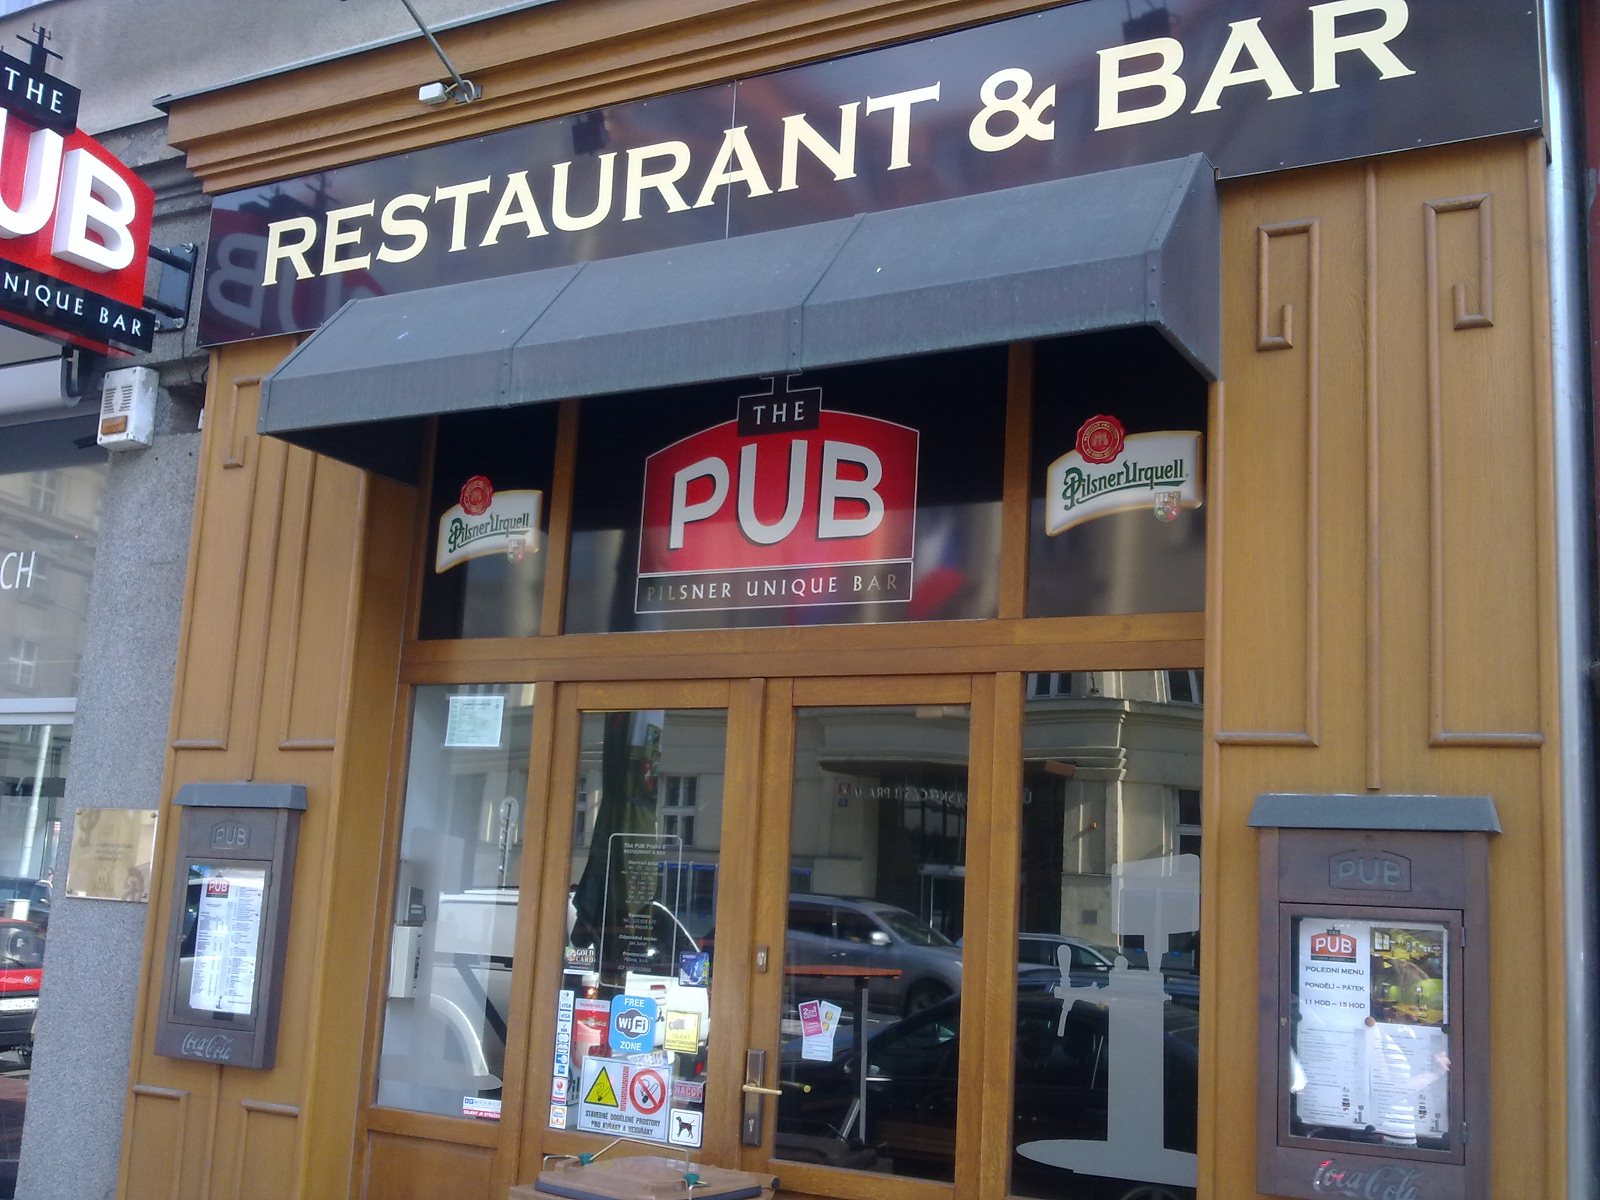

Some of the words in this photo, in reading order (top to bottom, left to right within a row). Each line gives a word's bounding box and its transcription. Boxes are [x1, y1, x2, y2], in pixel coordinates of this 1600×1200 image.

[5, 66, 63, 114] THE
[261, 81, 941, 286] RESTAURANT
[969, 68, 1055, 152] &
[1095, 0, 1416, 131] BAR
[4, 271, 84, 316] NIQUE
[99, 307, 141, 336] BAR
[753, 401, 805, 424] THE
[669, 439, 885, 549] PUB
[1062, 467, 1125, 511] Pilsner
[1122, 459, 1184, 490] Urquell
[448, 518, 491, 553] Pilsner
[490, 513, 530, 538] Urquell
[647, 583, 731, 602] PILSNER
[746, 577, 838, 597] UNIQUE
[853, 574, 897, 592] BAR
[215, 826, 246, 845] PUB
[1338, 857, 1402, 886] PUB
[208, 880, 228, 892] PUB
[576, 949, 594, 957] GOLD
[1315, 936, 1353, 953] PUB
[1341, 968, 1364, 976] MENU
[624, 998, 645, 1008] FREE
[1314, 999, 1331, 1007] HOD
[619, 1040, 642, 1051] ZONE
